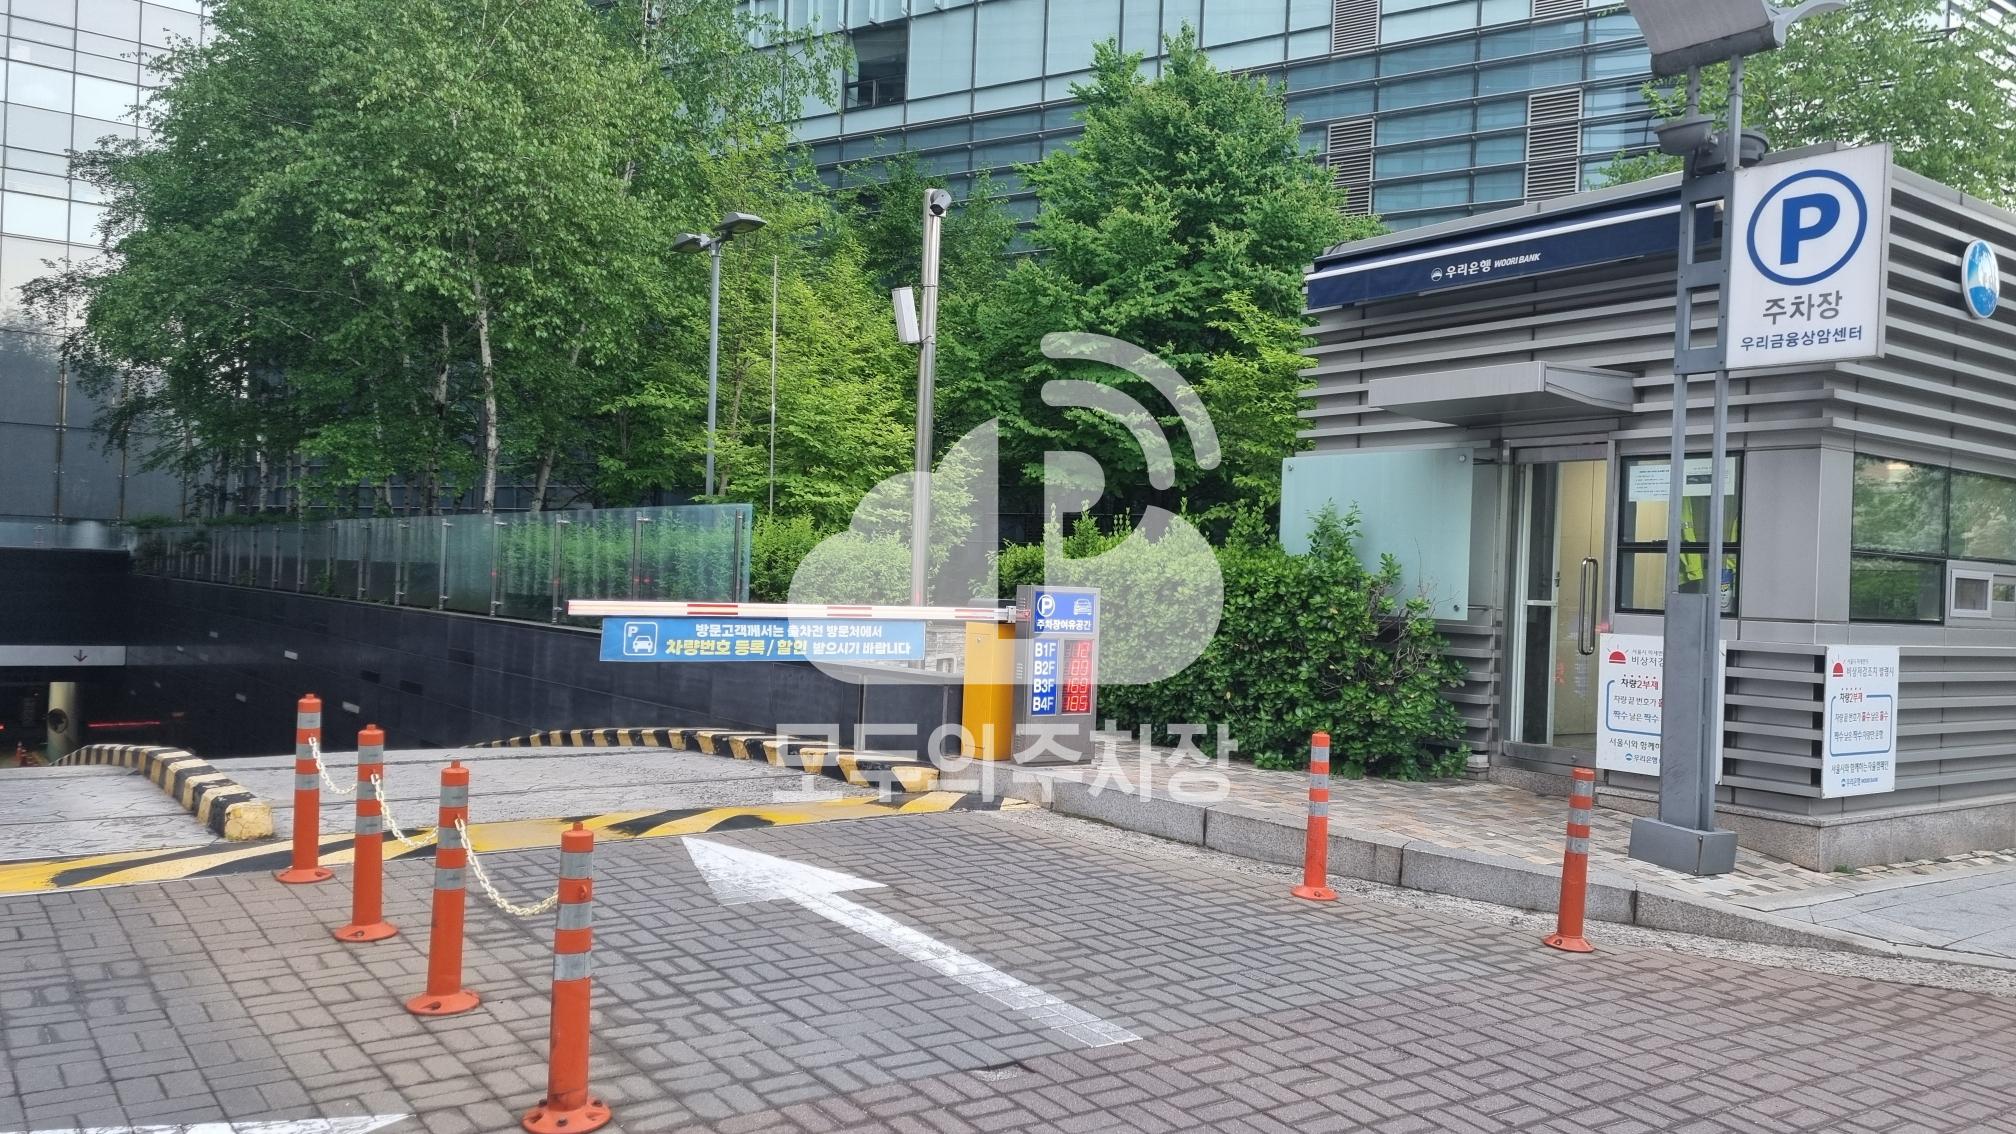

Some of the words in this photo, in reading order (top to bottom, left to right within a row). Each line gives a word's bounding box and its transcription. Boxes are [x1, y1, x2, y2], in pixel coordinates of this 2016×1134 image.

[1780, 193, 1840, 265] P
[1445, 259, 1491, 278] 우리은행
[1494, 256, 1518, 268] WOORI
[1519, 253, 1541, 264] BANK
[1762, 290, 1842, 325] 주차장
[1740, 325, 1862, 351] 우리금융상암센터
[696, 624, 784, 638] 방문고객께서는
[788, 625, 823, 638] 출차전
[827, 625, 882, 638] 방문처에서
[1036, 618, 1091, 631] 주차장여유공간
[665, 639, 731, 656] 차량번호
[813, 641, 859, 655] 받으시기
[863, 642, 911, 655] 바랍니다
[1035, 642, 1056, 657] B1F
[1034, 661, 1055, 675] B2F
[1033, 679, 1054, 693] B3F
[1621, 679, 1659, 690] 차량2부제
[1032, 697, 1054, 711] B4F
[1840, 692, 1863, 703] 차량2부제
[1609, 737, 1638, 749] 서울시와
[1634, 754, 1658, 764] 우리은행
